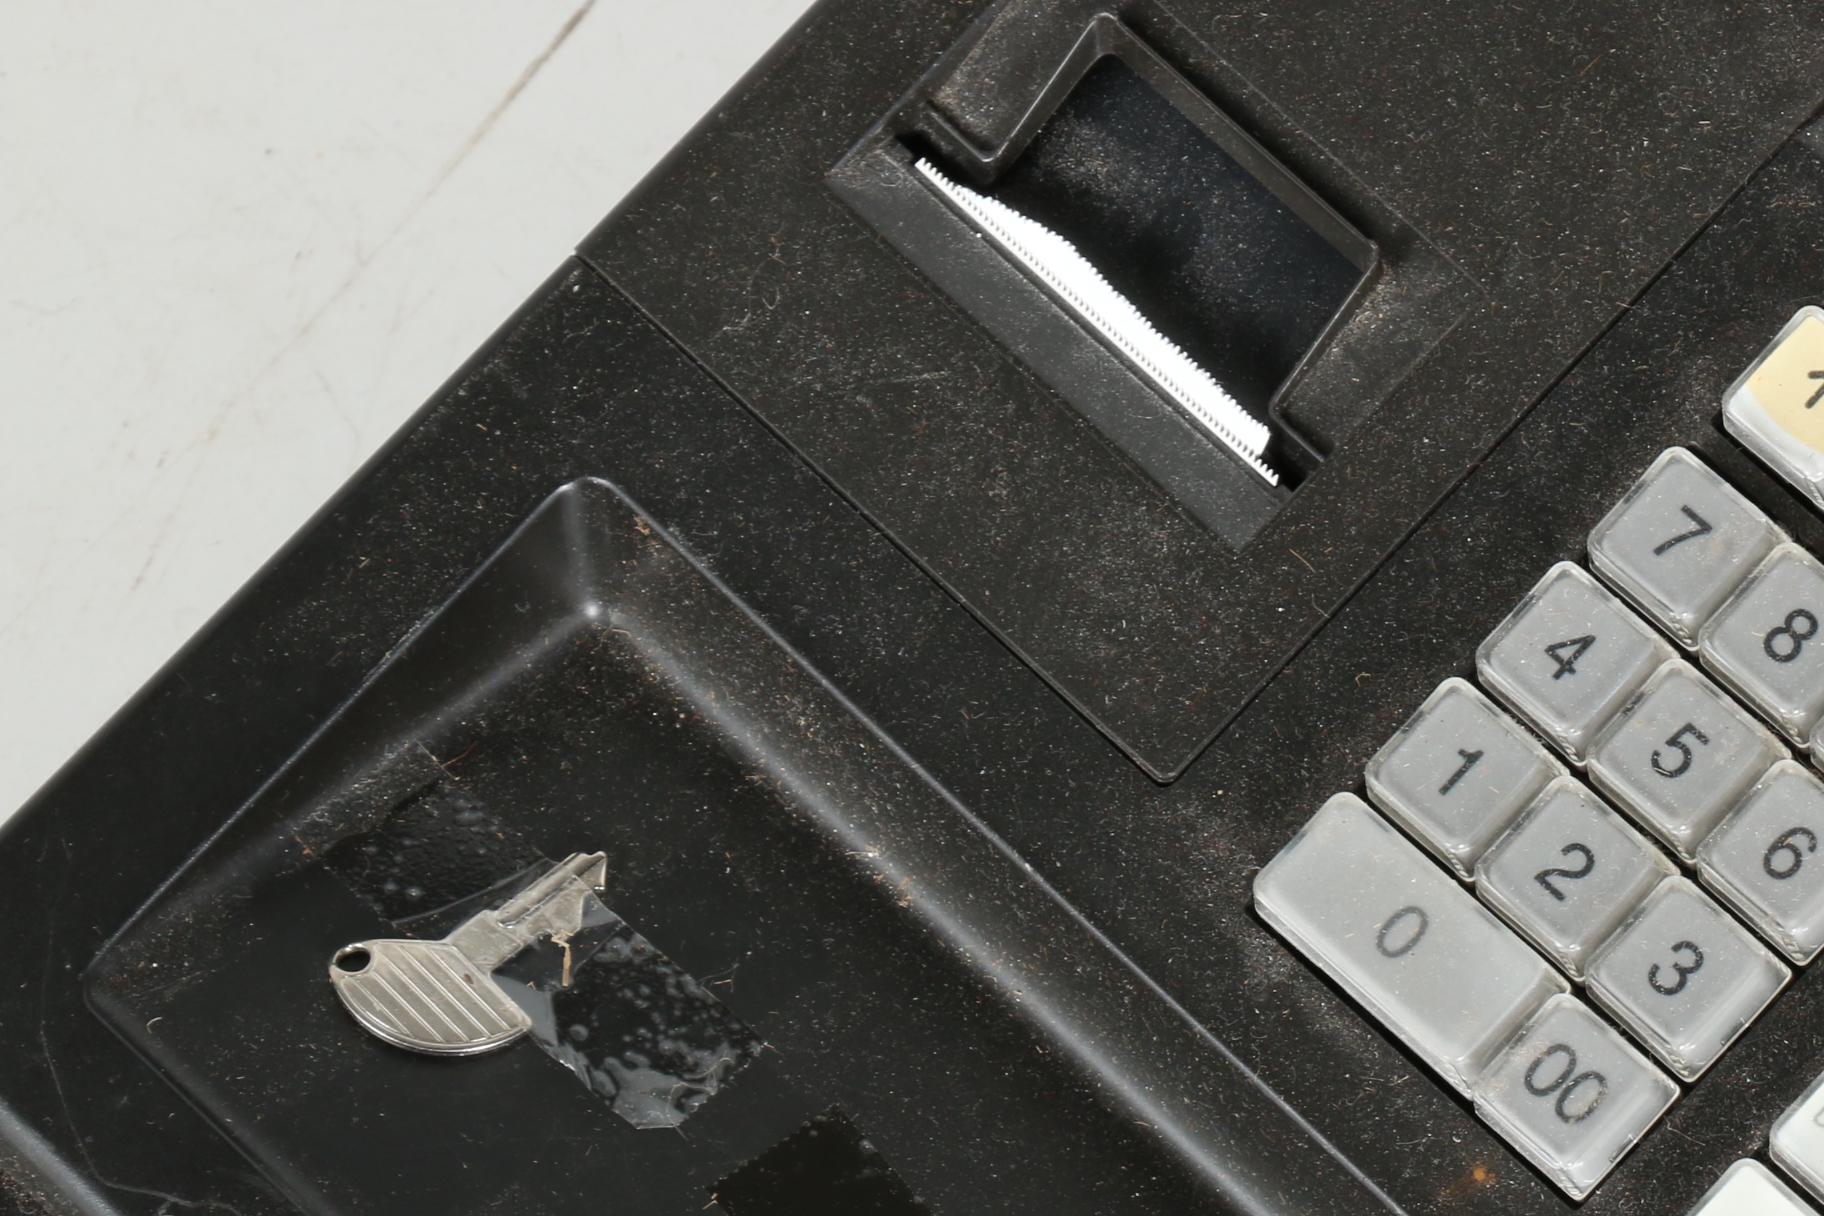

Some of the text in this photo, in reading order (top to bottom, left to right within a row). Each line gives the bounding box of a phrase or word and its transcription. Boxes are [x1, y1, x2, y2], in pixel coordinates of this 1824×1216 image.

[1653, 504, 1714, 557] 7
[1543, 633, 1597, 682] 4
[1763, 608, 1820, 664] 8
[1438, 747, 1485, 796] 1
[1650, 721, 1711, 780] 5
[1533, 842, 1595, 903] 2
[1761, 825, 1819, 882] 6
[1374, 905, 1430, 960] 0
[1646, 940, 1706, 999] 3
[1522, 1041, 1609, 1125] 00
